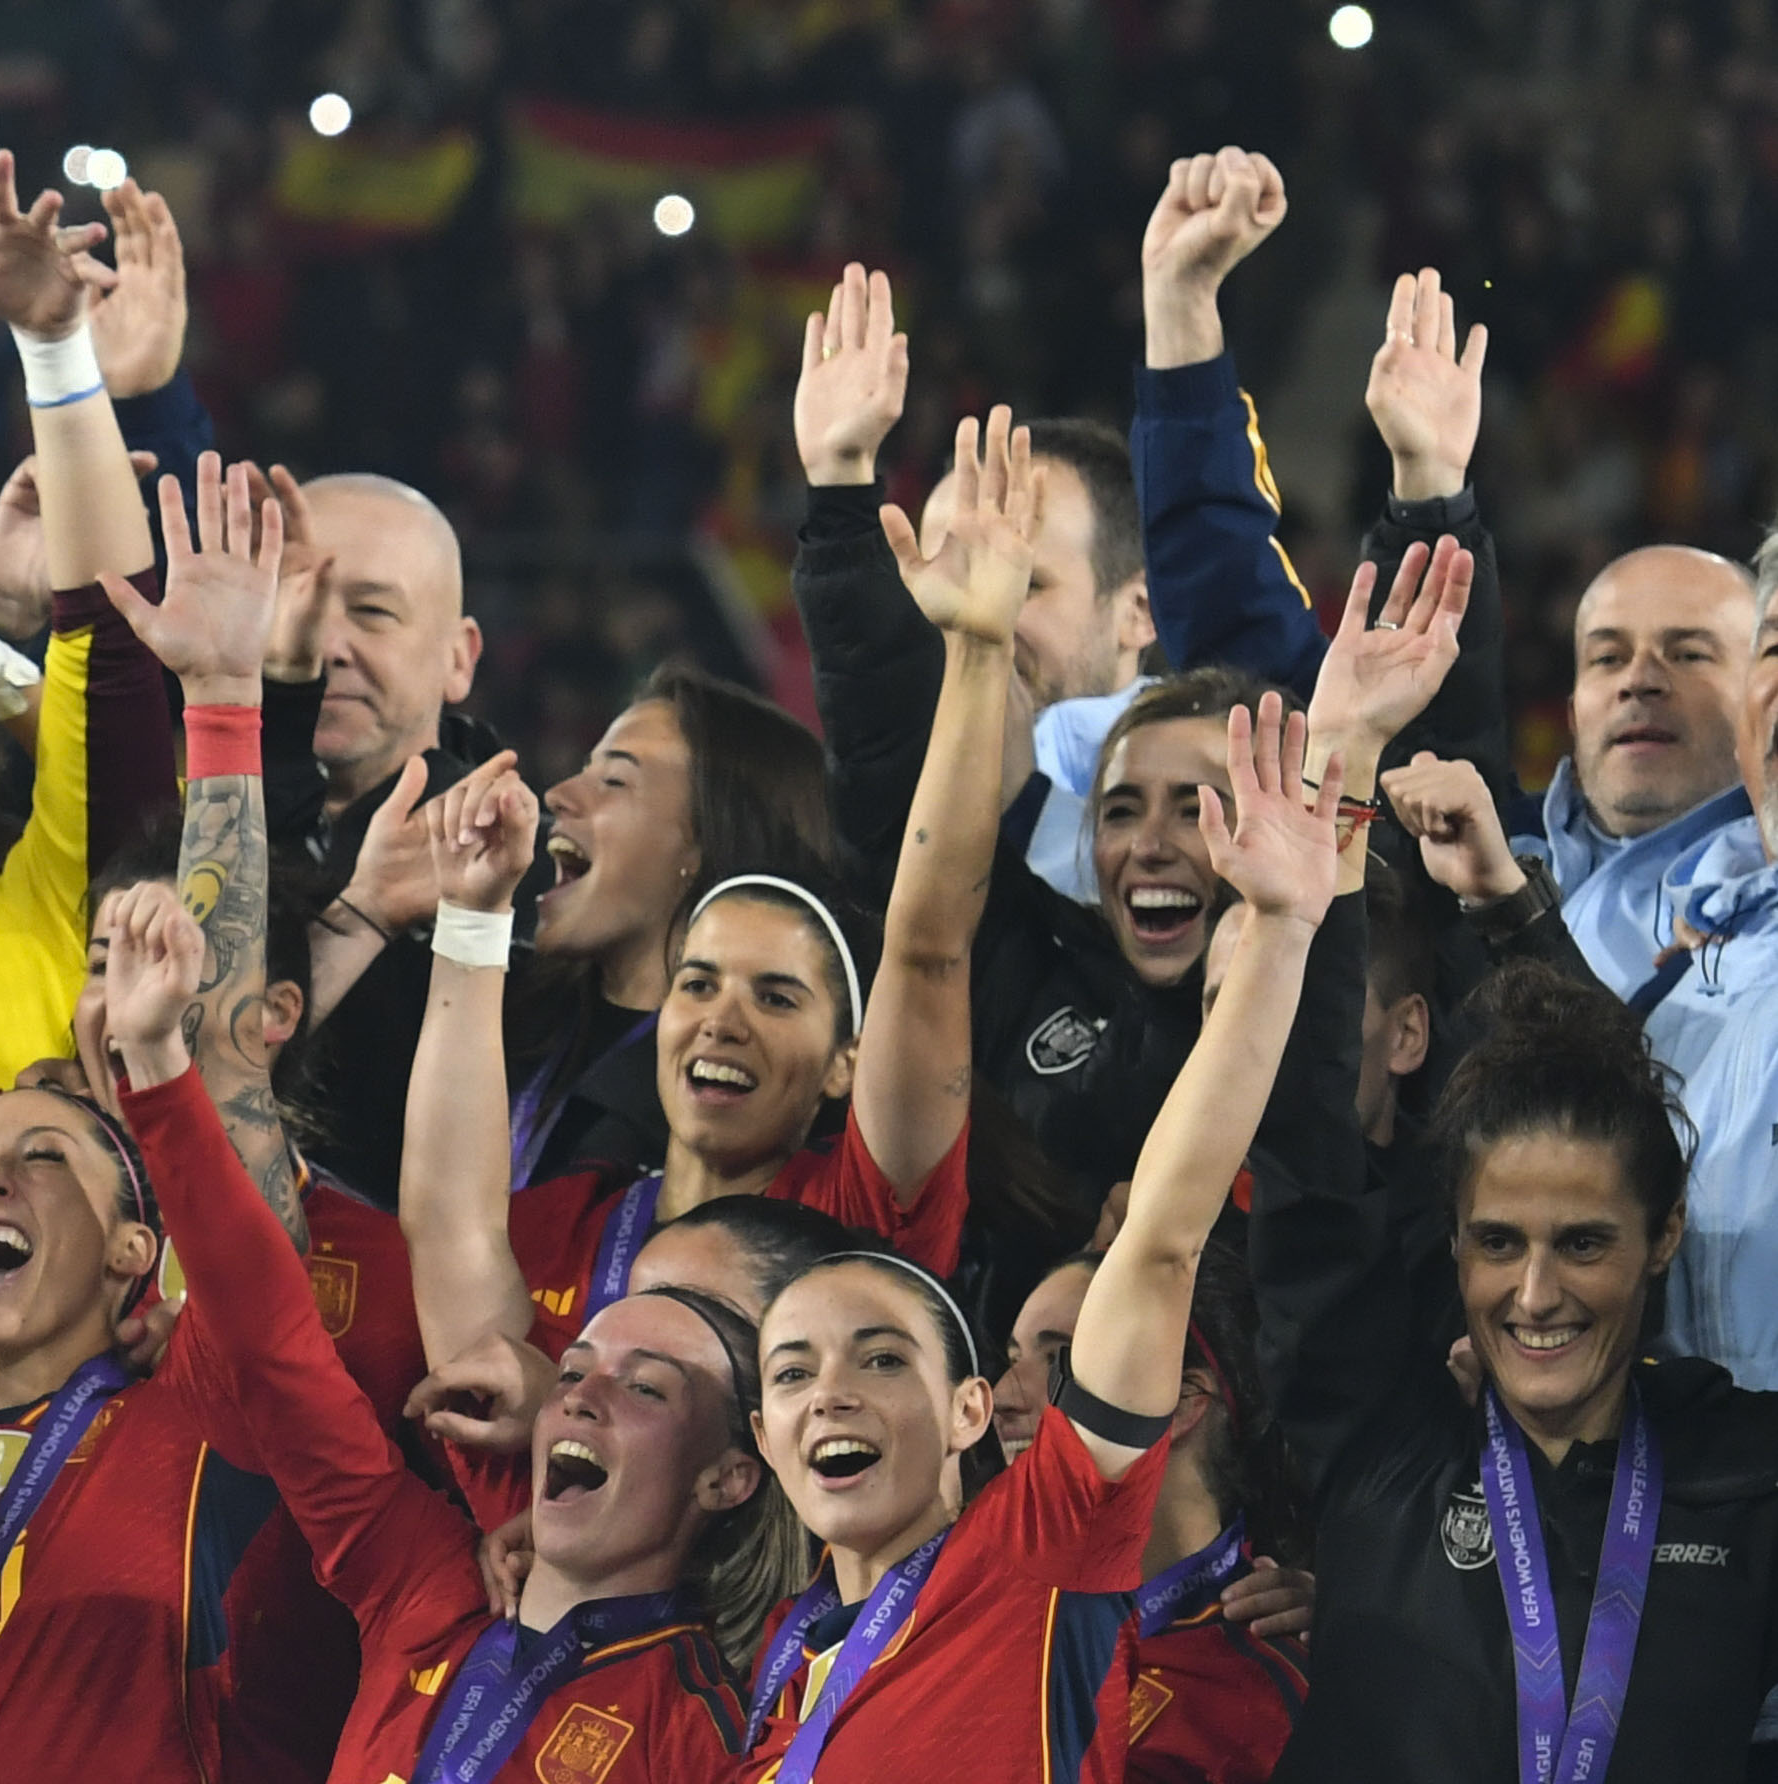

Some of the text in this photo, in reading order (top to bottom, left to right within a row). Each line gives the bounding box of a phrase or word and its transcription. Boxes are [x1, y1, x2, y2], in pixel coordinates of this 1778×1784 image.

[25, 1420, 69, 1487] NATIONS
[1491, 1435, 1520, 1509] NATIONS
[1622, 1469, 1648, 1536] LEAGUE
[862, 1531, 944, 1642] TIONS LEAGUE
[1145, 1568, 1212, 1614] NATIONS
[1521, 1585, 1541, 1628] UEFA
[463, 1684, 486, 1715] UEFA
[511, 1646, 567, 1710] NATIONS
[1571, 1737, 1597, 1783] UEFA
